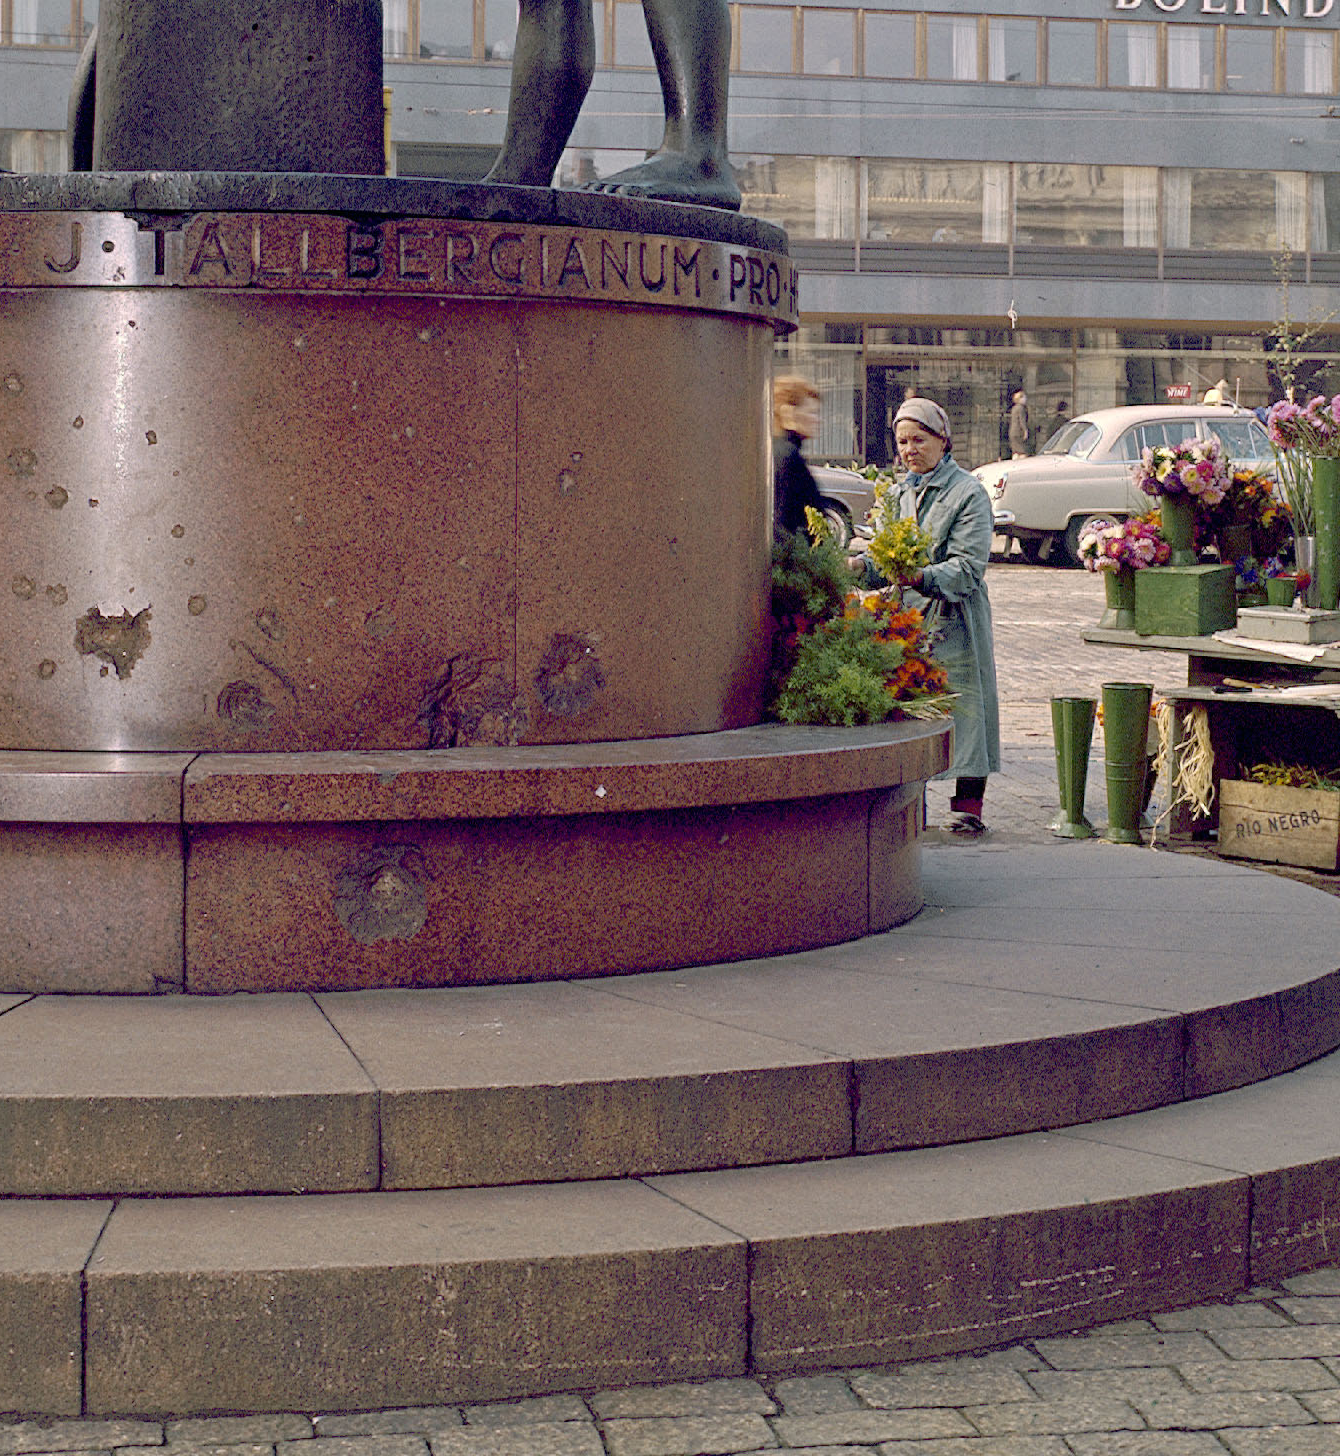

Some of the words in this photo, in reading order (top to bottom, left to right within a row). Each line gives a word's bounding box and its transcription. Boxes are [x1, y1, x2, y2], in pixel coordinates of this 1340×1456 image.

[147, 212, 701, 298] TALLBERGIANUM
[729, 252, 781, 307] PRO
[1236, 820, 1262, 839] RIO
[1267, 809, 1321, 834] NEGRO
